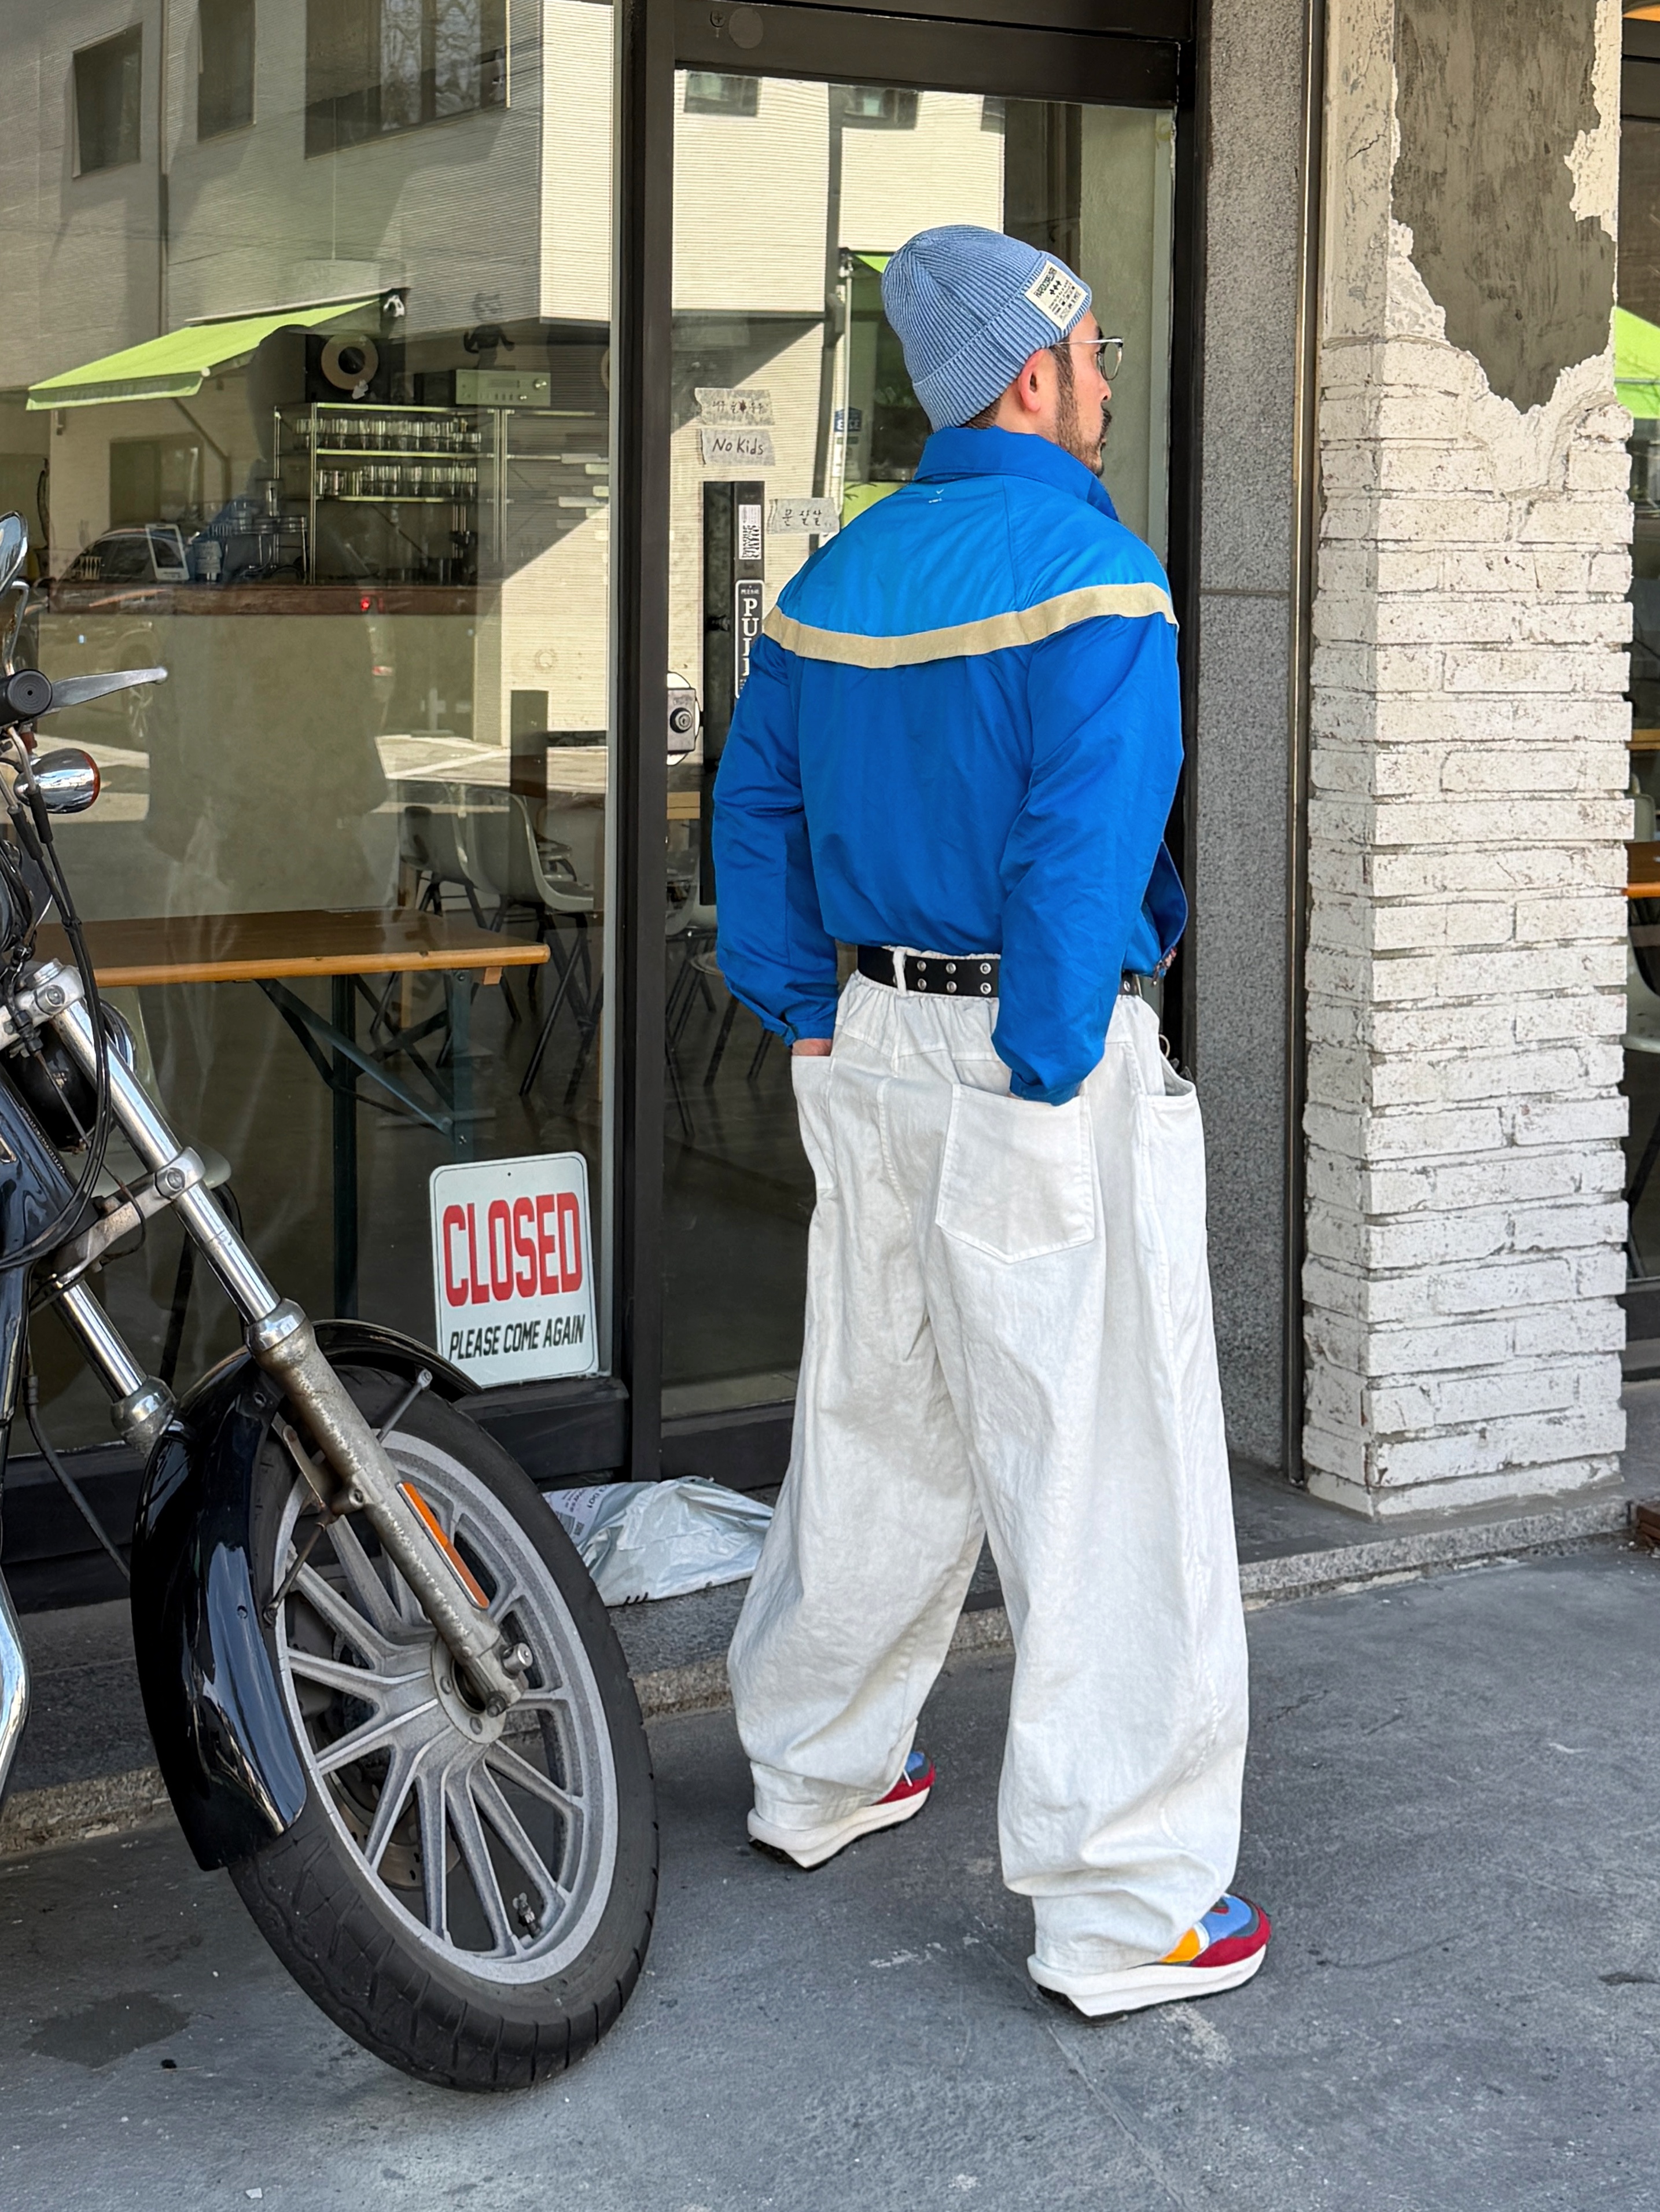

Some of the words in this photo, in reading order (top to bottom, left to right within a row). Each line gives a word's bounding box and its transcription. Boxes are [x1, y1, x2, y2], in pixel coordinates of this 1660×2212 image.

[712, 438, 733, 452] No
[737, 436, 764, 455] Kids
[443, 1192, 583, 1306] CLOSED
[449, 1325, 501, 1361] PLEASE
[503, 1319, 541, 1353] COME
[543, 1313, 586, 1348] AGAIN
